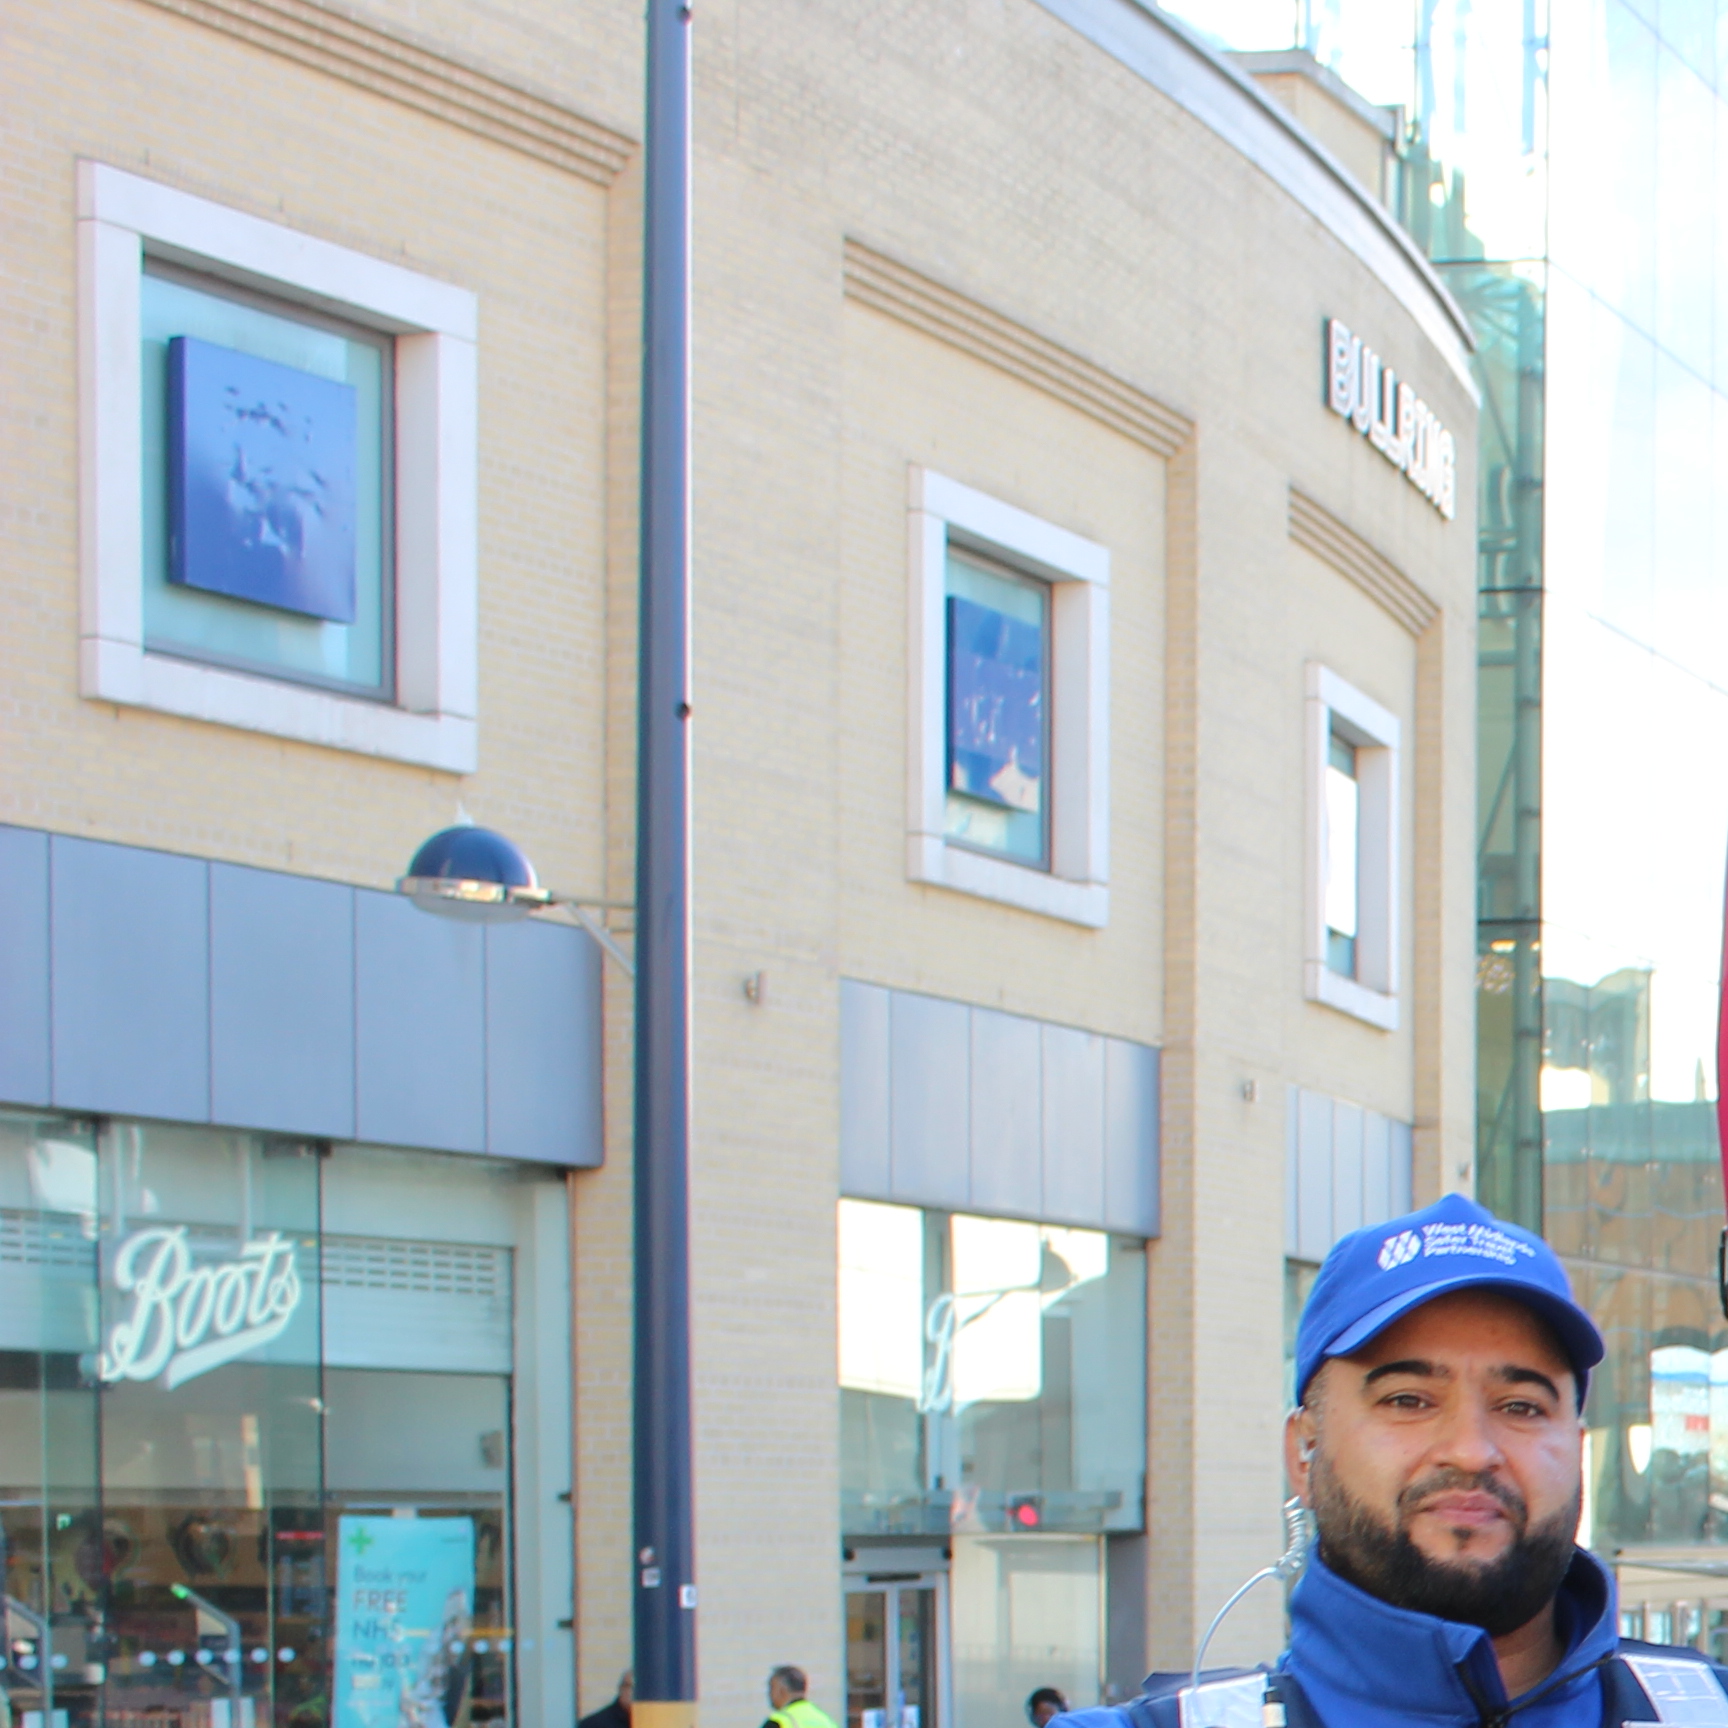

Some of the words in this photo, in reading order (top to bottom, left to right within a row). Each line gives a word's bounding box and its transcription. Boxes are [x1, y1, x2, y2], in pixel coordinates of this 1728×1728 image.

[1324, 317, 1456, 521] BULLRING
[99, 1224, 302, 1391] Boots
[353, 1589, 409, 1614] FREE
